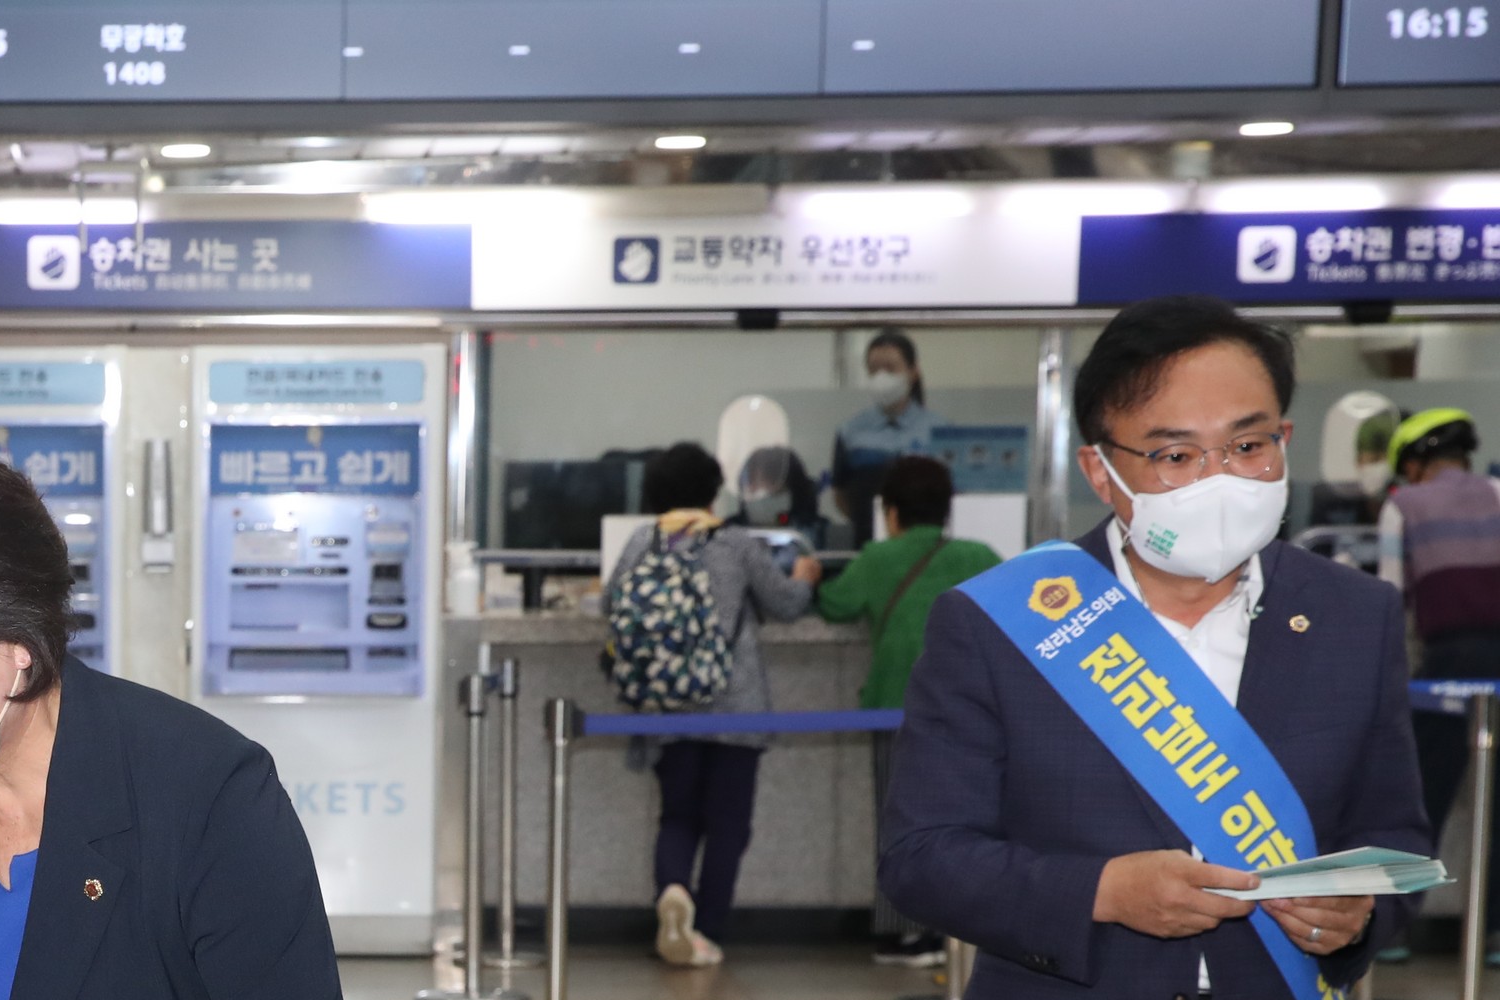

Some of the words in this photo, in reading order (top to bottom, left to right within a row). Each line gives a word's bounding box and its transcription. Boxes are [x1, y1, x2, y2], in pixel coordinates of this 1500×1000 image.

[1386, 7, 1488, 39] 16:15
[88, 238, 171, 274] 승차권
[184, 238, 239, 272] 사는
[251, 237, 279, 274] 곳
[672, 235, 784, 269] 교통약자
[799, 233, 913, 269] 우선창구
[218, 450, 327, 485] 빠르고
[336, 450, 411, 485] 쉽게
[1034, 586, 1127, 661] 전라남도의회
[1078, 632, 1240, 804] 전라남도
